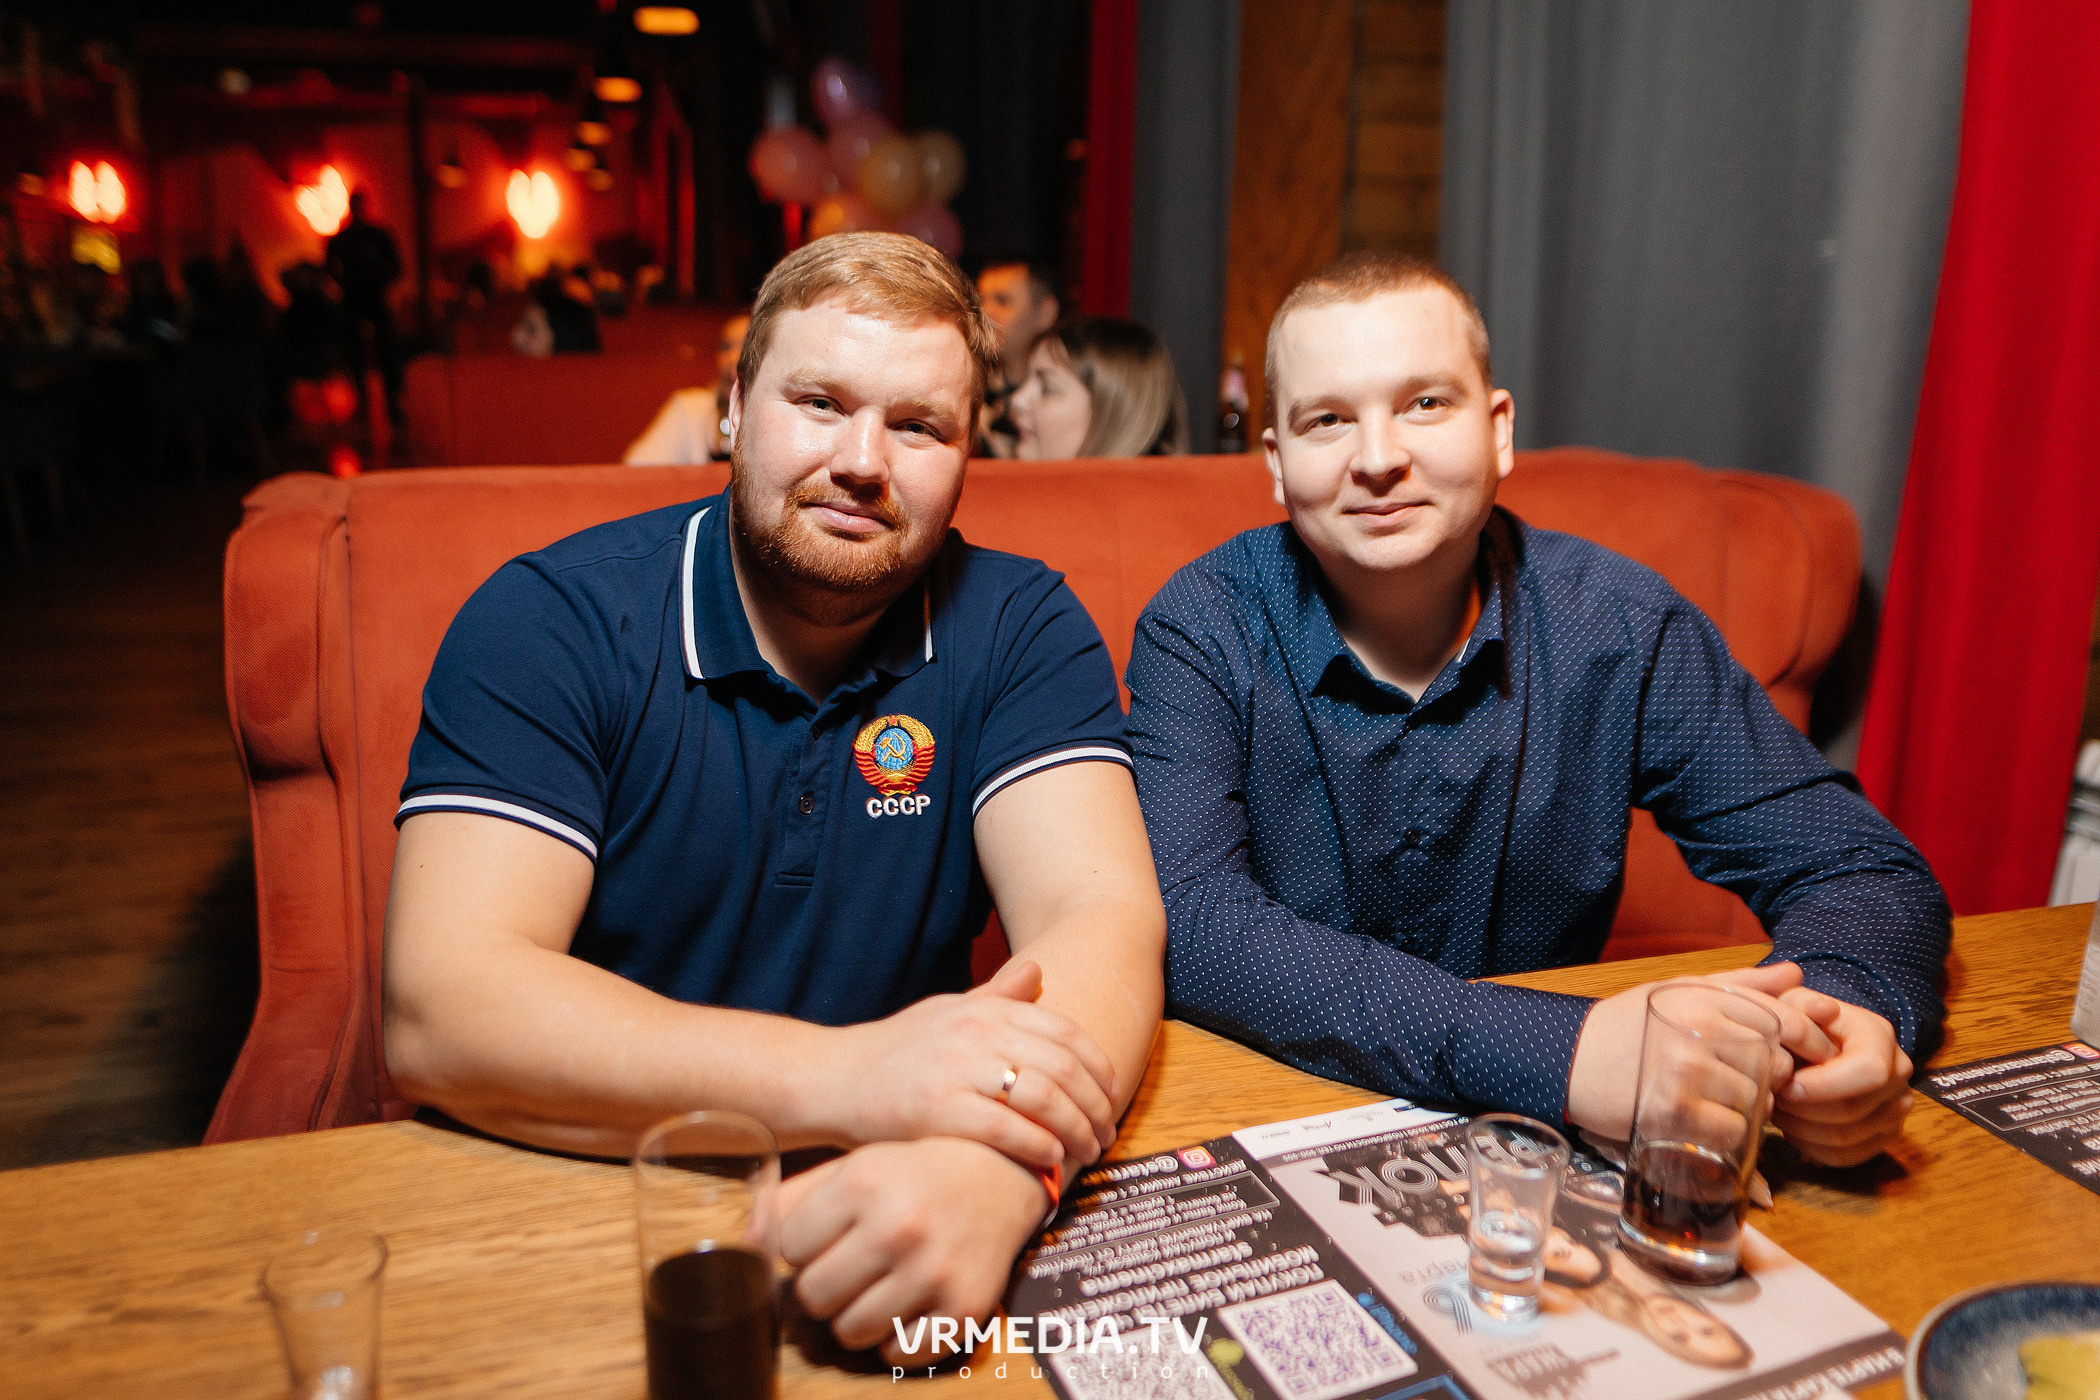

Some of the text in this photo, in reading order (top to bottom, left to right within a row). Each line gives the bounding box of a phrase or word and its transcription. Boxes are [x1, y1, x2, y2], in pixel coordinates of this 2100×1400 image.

[865, 793, 931, 819] СССР
[1139, 1175, 1181, 1193] АКЦИИ
[1182, 1159, 1247, 1184] ДЕЙСТВИЕ
[1251, 1207, 1273, 1222] НА
[1158, 1213, 1253, 1248] ВИРТУАЛЬНУЮ
[1096, 1247, 1118, 1263] ОТ
[1116, 1237, 1158, 1257] КАРТУ
[1161, 1230, 1224, 1259] ПОЛУЧАЙ
[1081, 1241, 1253, 1296] starmaxcinema
[1188, 1245, 1319, 1293] МОБИЛЬНОЕ
[1225, 1263, 1324, 1302] ПОКУПАЙ
